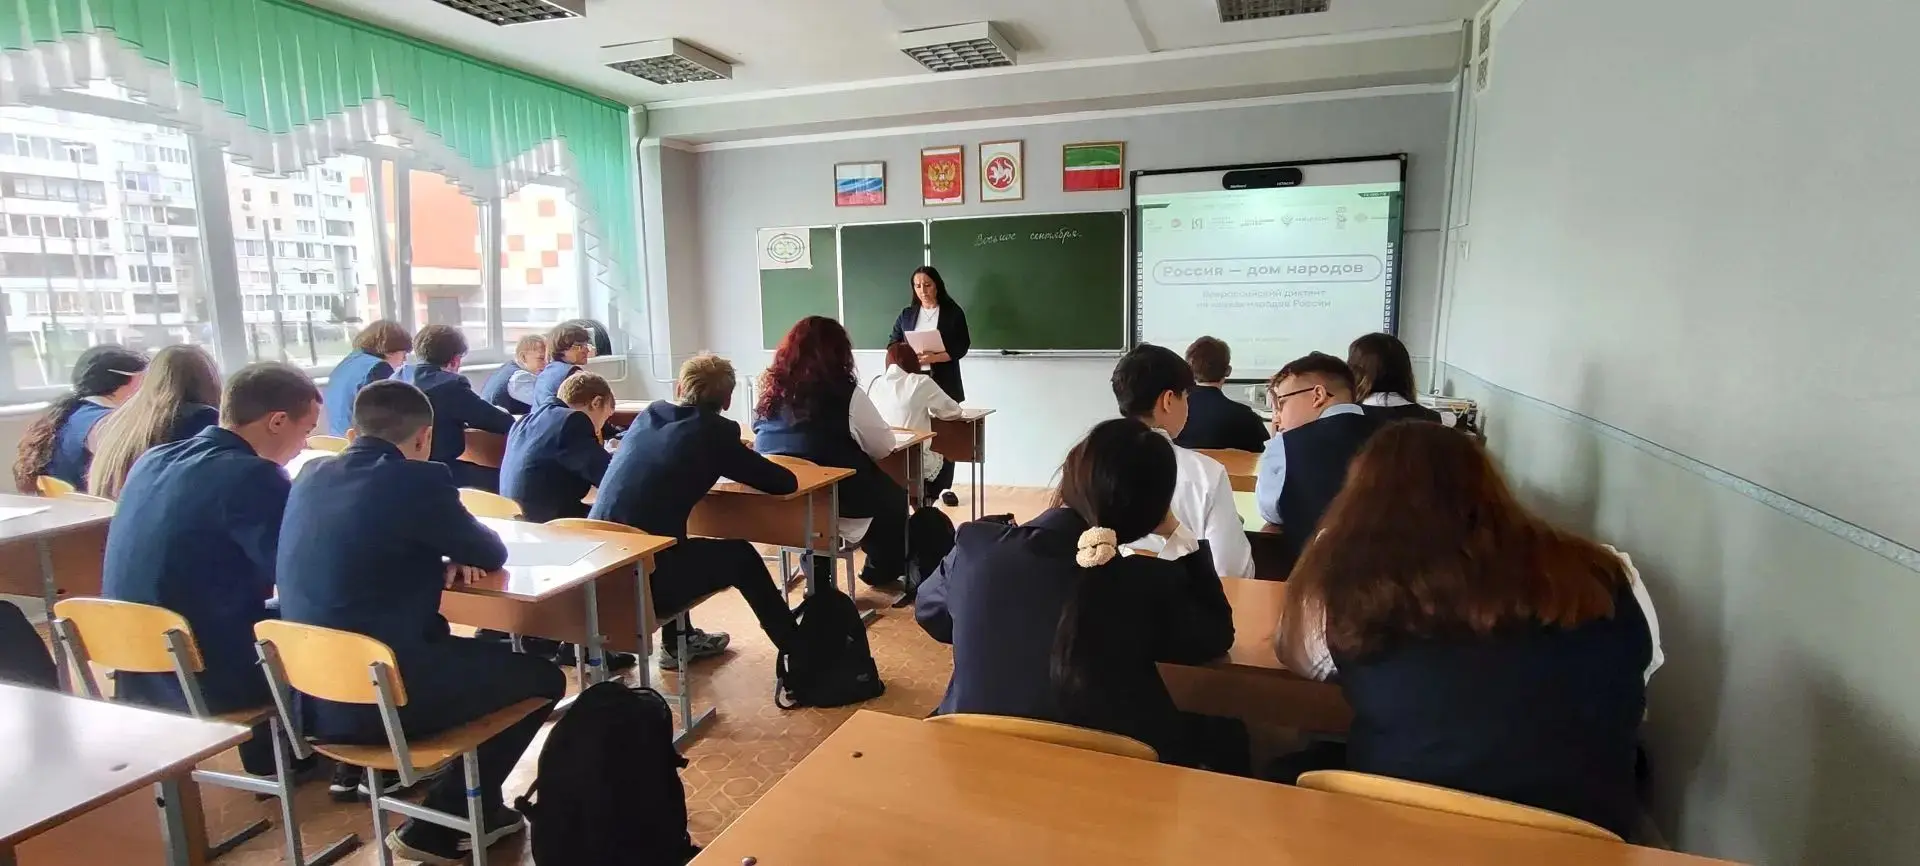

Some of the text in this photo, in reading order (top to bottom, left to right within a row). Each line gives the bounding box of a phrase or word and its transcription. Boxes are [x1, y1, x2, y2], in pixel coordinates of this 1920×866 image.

[1163, 265, 1224, 277] Россия
[1246, 264, 1281, 277] дом
[1286, 262, 1365, 276] народов
[1292, 298, 1331, 308] России
